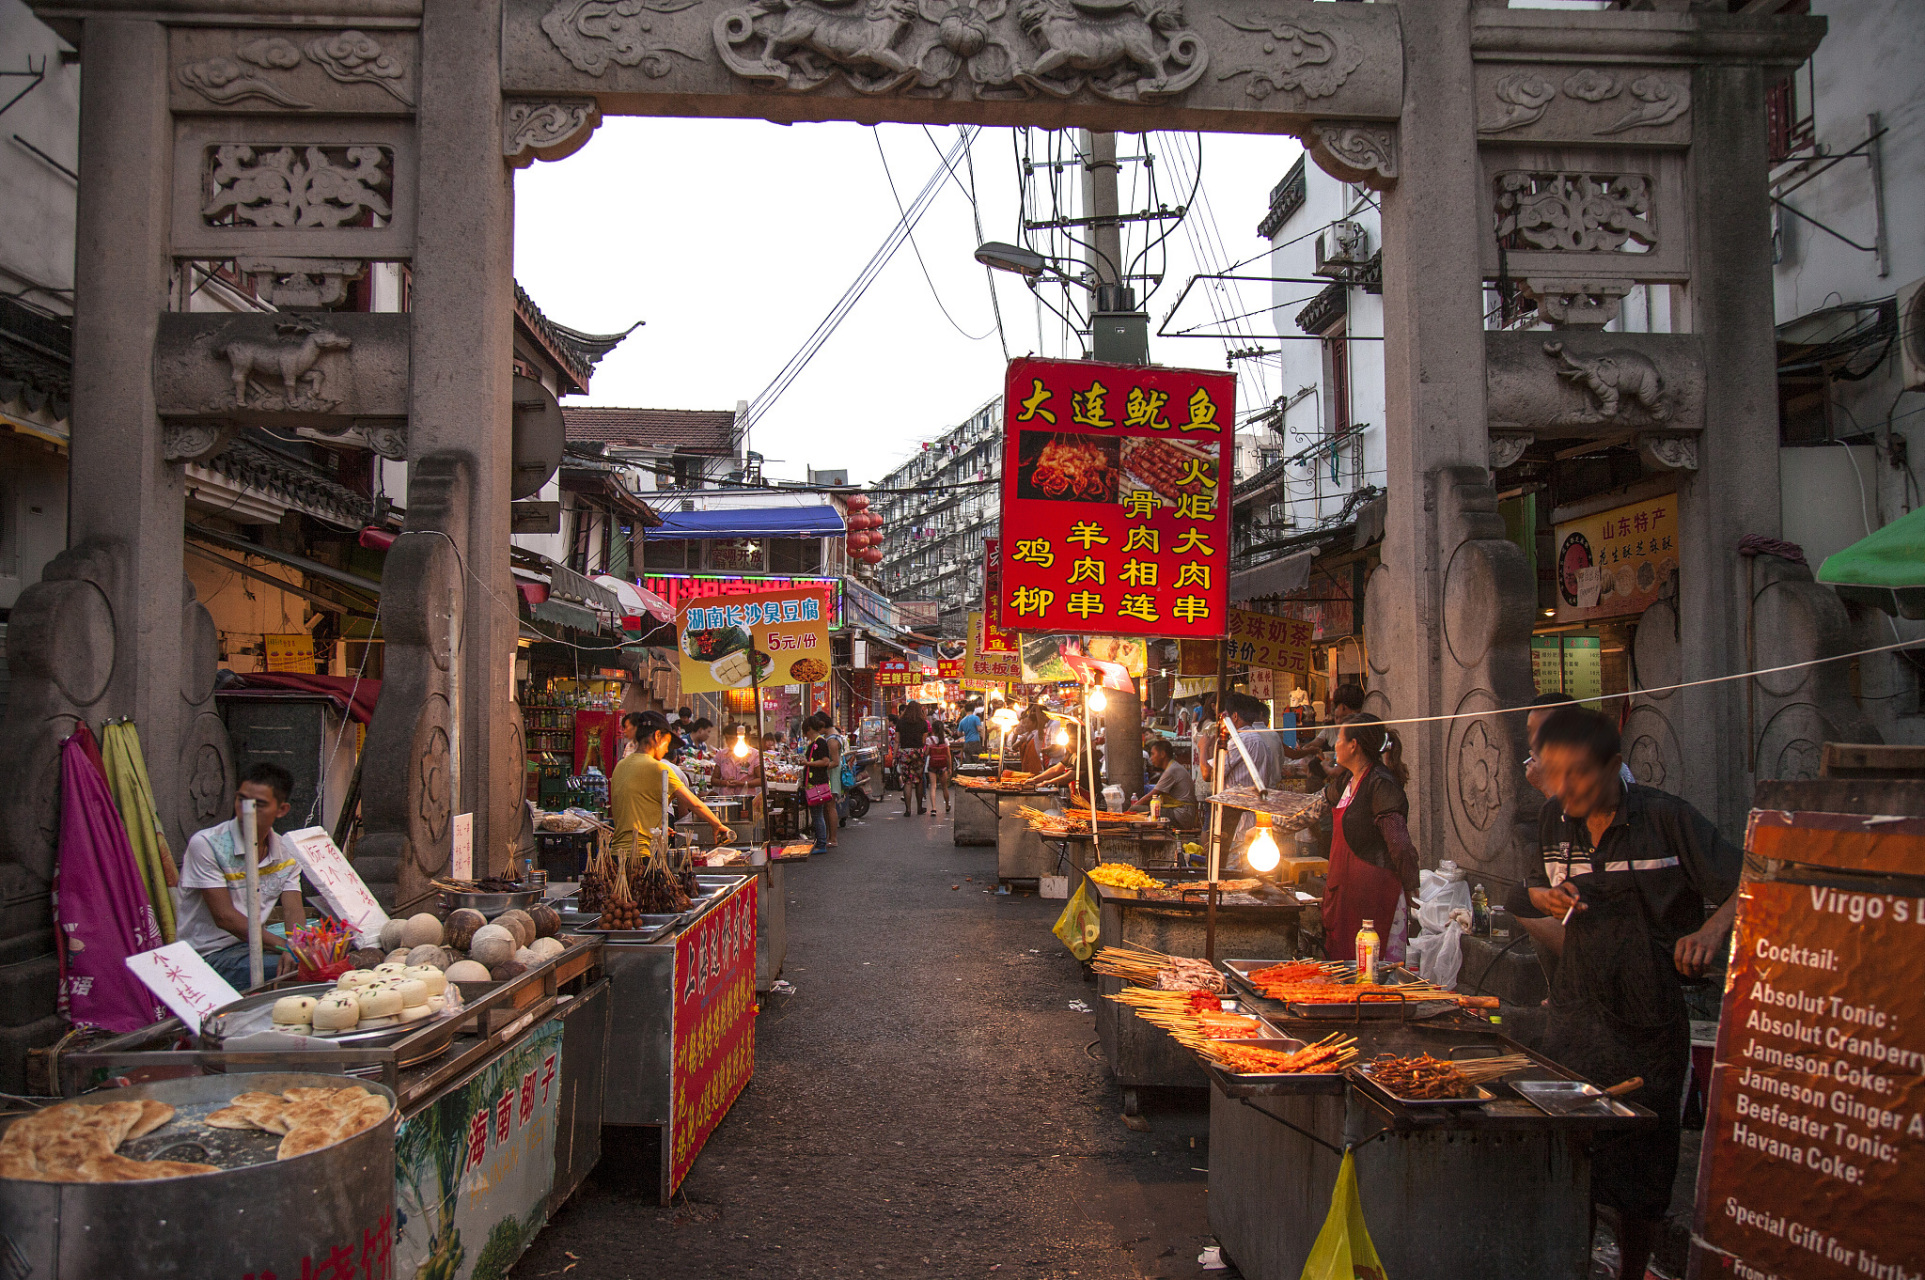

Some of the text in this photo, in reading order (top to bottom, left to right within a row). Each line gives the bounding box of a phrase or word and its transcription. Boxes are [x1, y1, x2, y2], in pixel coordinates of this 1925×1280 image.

[1016, 378, 1222, 434] 大连鱿鱼
[1172, 458, 1218, 624] 火炬大肉串
[1602, 507, 1667, 541] 山东特产
[1010, 537, 1055, 618] 鸡柳
[1066, 520, 1110, 619] 羊肉串
[1117, 489, 1161, 622] 骨肉相连
[685, 597, 820, 631] 湖南长沙臭豆腐
[767, 632, 818, 651] 5元/份
[881, 673, 922, 685] 三鲜豆皮
[1810, 884, 1909, 924] Virgo's
[1755, 937, 1839, 972] Cocktail:
[1746, 1008, 1823, 1046] Absolut
[1749, 981, 1825, 1016] Absolut
[1742, 1038, 1894, 1096] Jameson Coke:
[466, 1051, 558, 1174] 海南椰子
[1735, 1093, 1899, 1164] Beefeater Tonic:
[1738, 1066, 1826, 1109] Jameson
[1830, 1090, 1903, 1132] Ginger
[469, 1114, 548, 1211] HAINAN YEZI
[1732, 1121, 1864, 1186] Havana Coke:
[1725, 1196, 1787, 1239] Special
[1788, 1221, 1825, 1255] Gift
[1827, 1237, 1855, 1267] for
